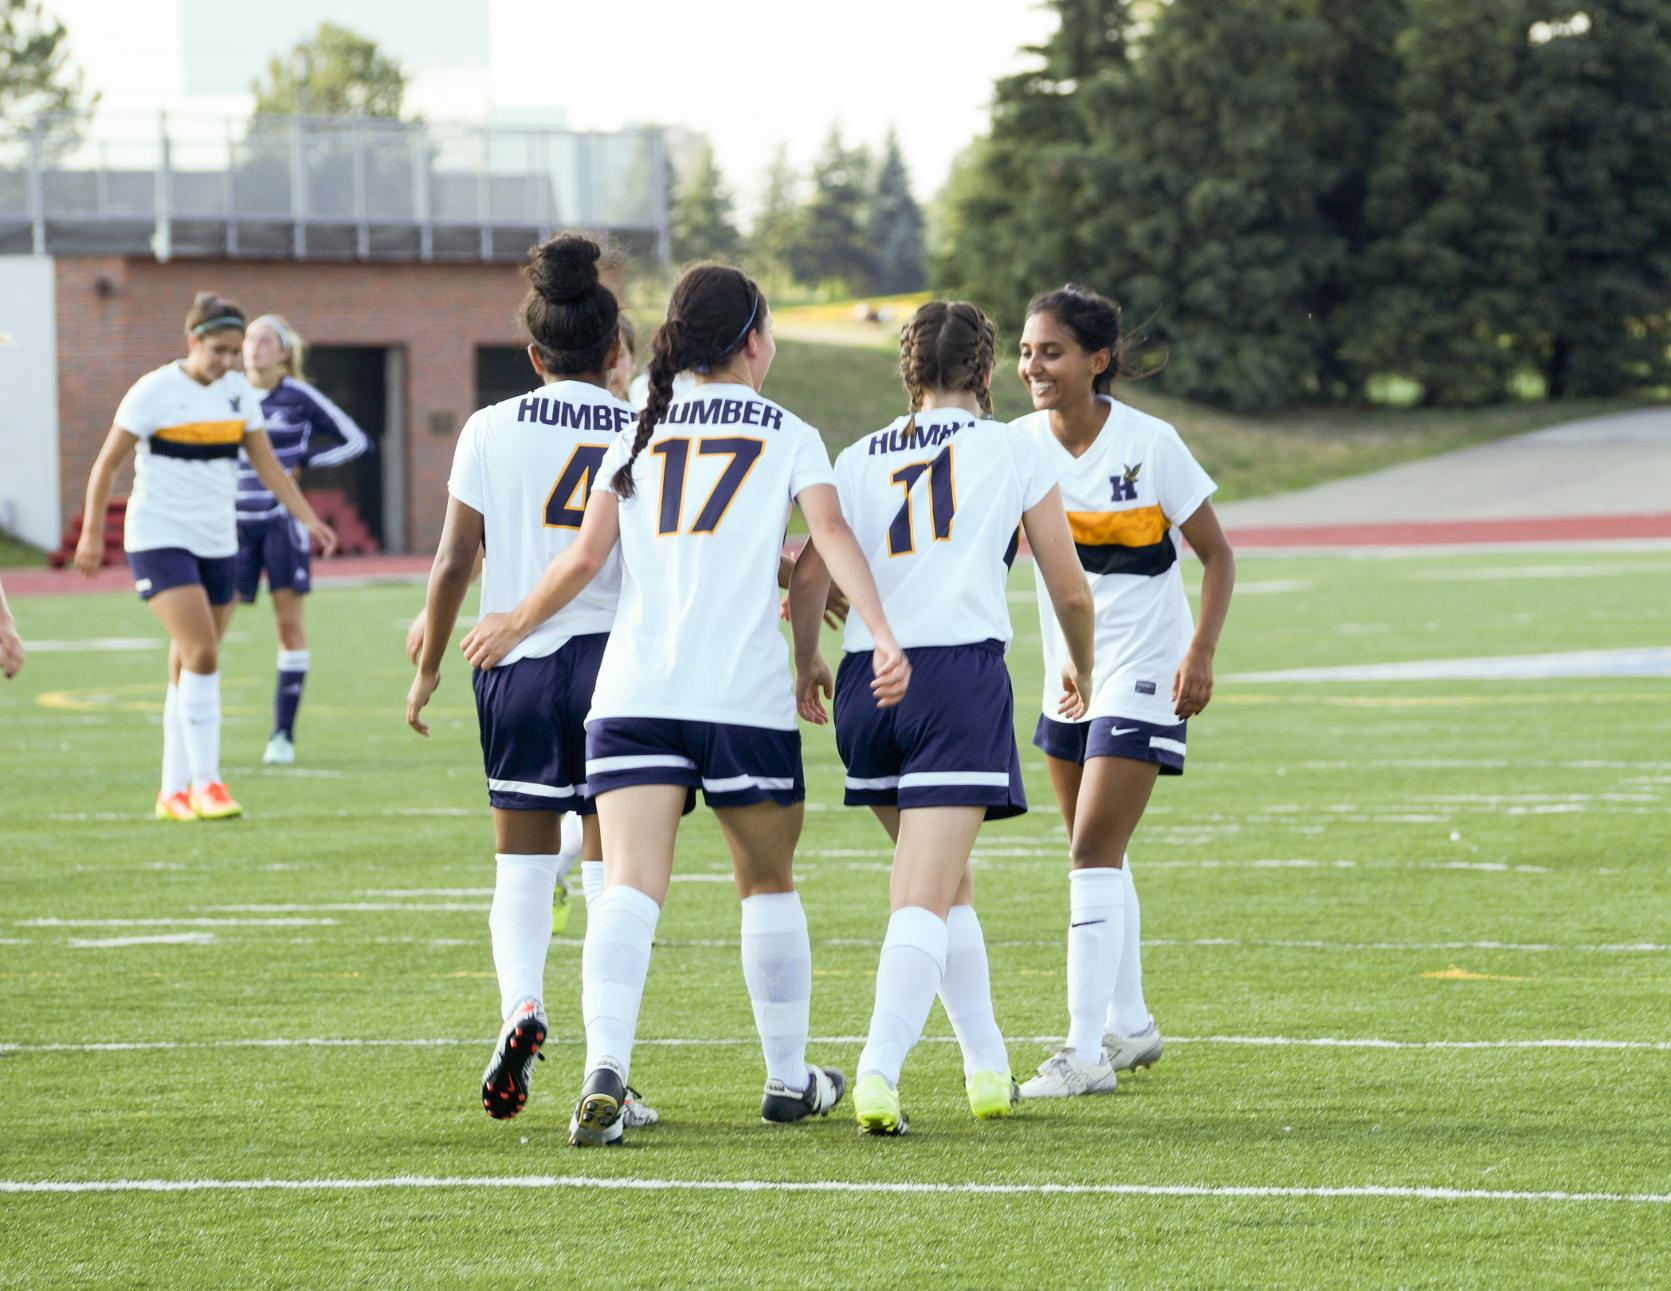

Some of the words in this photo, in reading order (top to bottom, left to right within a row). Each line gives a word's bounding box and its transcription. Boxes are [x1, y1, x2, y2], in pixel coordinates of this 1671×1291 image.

[656, 398, 783, 430] UMBER
[543, 443, 609, 530] 4
[650, 436, 766, 536] 17
[887, 443, 956, 558] 11
[1110, 475, 1137, 502] H
